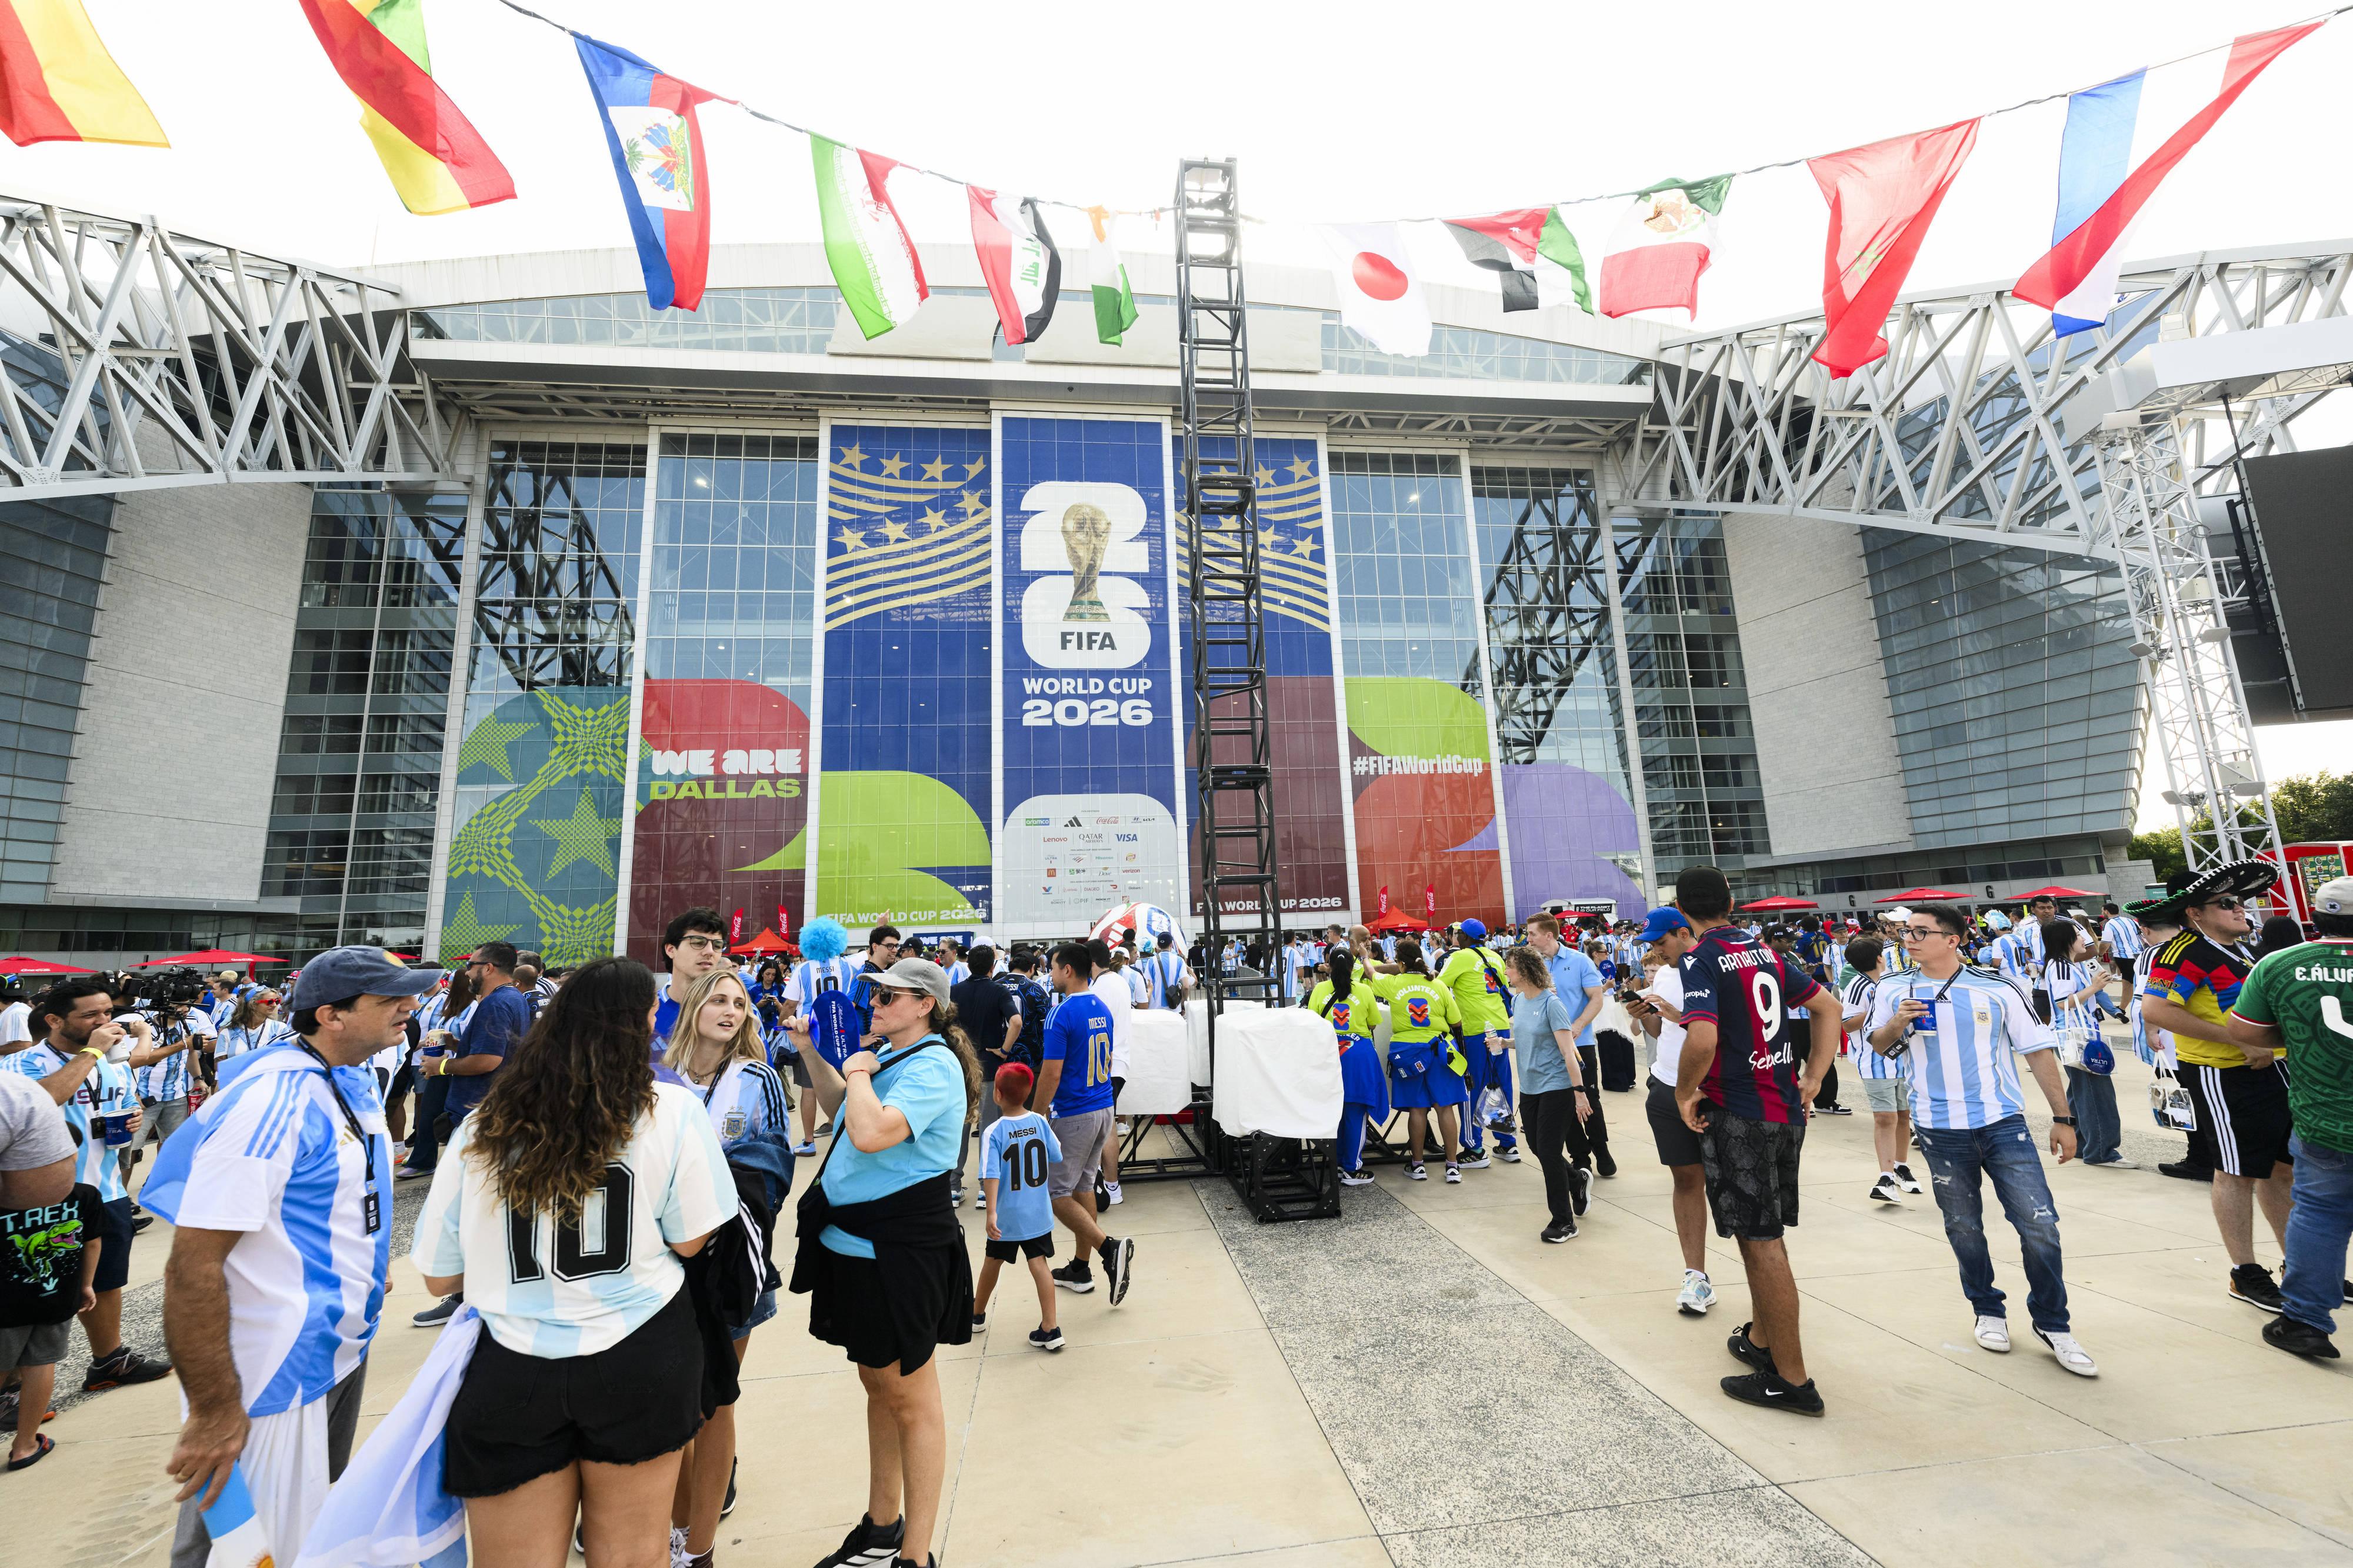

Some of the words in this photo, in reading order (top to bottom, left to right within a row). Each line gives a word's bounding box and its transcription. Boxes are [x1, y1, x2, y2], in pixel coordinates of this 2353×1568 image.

[1061, 631, 1117, 650] FIFA
[1022, 678, 1104, 694] WORLD
[1108, 678, 1152, 694] CUP
[1022, 699, 1153, 726] 2026
[652, 749, 715, 775] WE
[1353, 753, 1484, 777] #FIFAWorldCup
[649, 779, 801, 800] DALLAS
[1115, 833, 1138, 842] VISA
[1848, 895, 1855, 906] G
[1986, 885, 1995, 899] G
[1225, 900, 1271, 911] WORL
[1299, 897, 1342, 908] 2026
[857, 912, 907, 923] WOLD
[909, 910, 936, 922] CUP
[939, 908, 987, 920] 2026
[919, 936, 938, 945] WE
[1395, 985, 1440, 1000] VOLUNTEER
[1752, 971, 1781, 1043] 9
[1088, 1016, 1106, 1029] MESSI
[1086, 1032, 1111, 1087] 10
[1008, 1127, 1037, 1139] MESSI
[1002, 1138, 1048, 1192] 10
[0, 1200, 79, 1233] T.REX
[503, 1161, 635, 1285] 10
